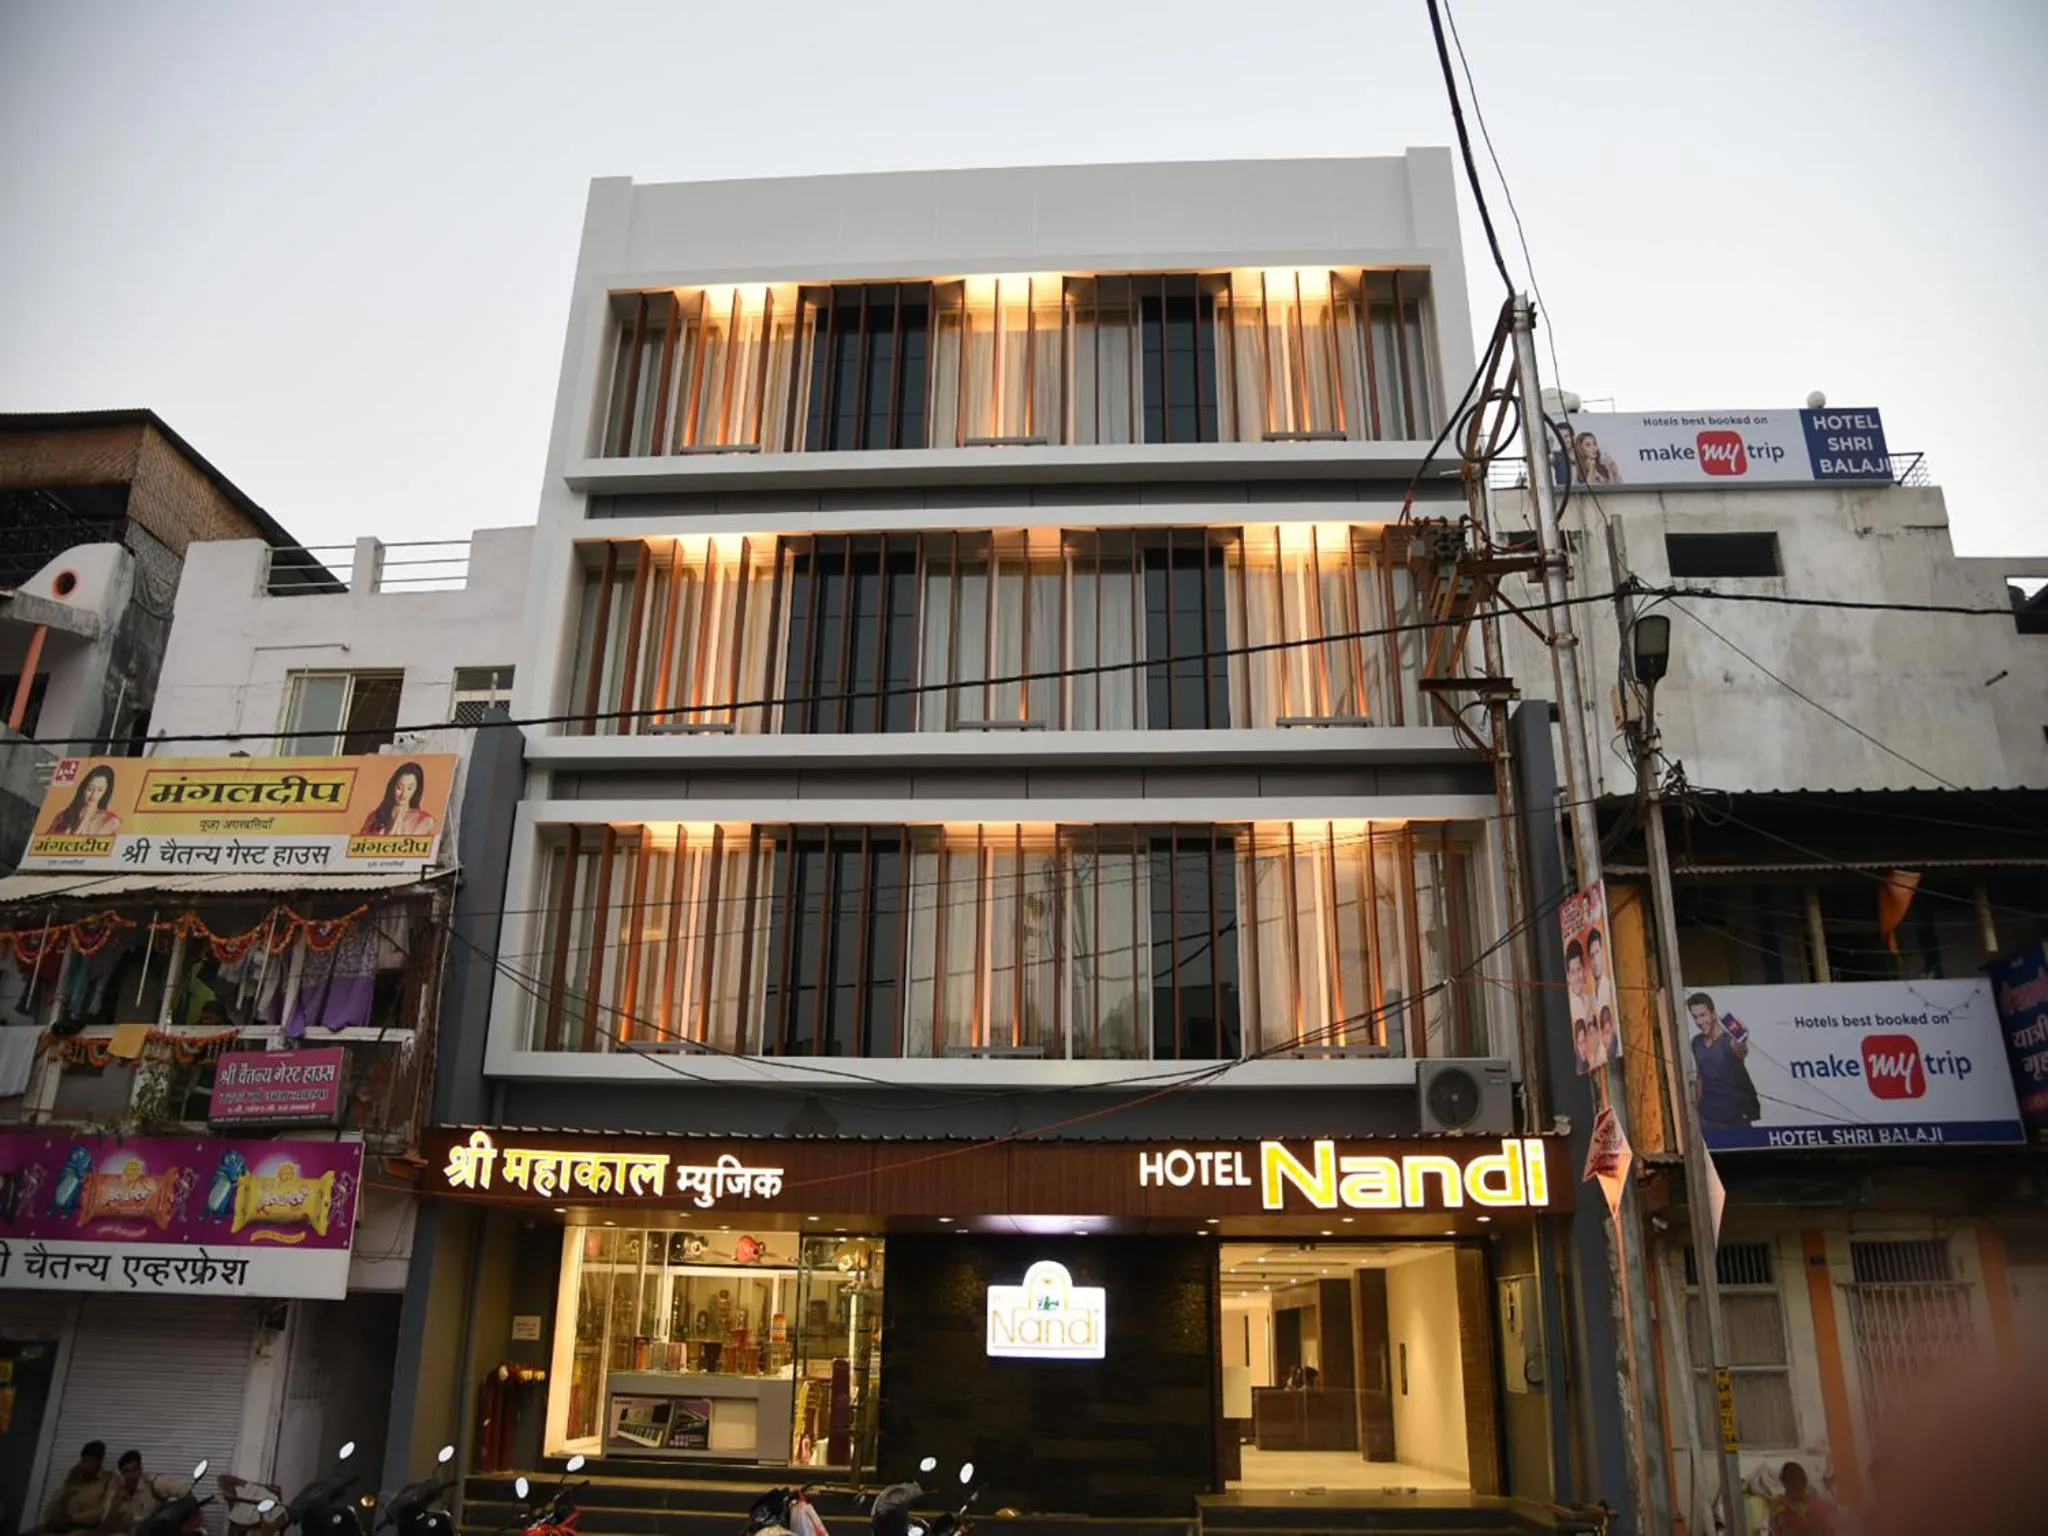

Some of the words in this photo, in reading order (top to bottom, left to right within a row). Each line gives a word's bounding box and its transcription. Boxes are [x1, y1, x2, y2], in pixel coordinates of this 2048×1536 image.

[1643, 416, 1679, 427] Hotels
[1681, 416, 1705, 426] best
[1708, 415, 1751, 426] booked
[1753, 417, 1769, 426] on
[1813, 414, 1880, 430] HOTEL
[1639, 444, 1695, 462] make
[1701, 440, 1741, 473] my
[1746, 442, 1785, 464] trip
[1827, 436, 1873, 452] SHRI
[1820, 457, 1893, 474] BALAJI
[150, 777, 346, 805] मंगलदीप
[34, 839, 110, 856] मंगलदीप
[122, 838, 151, 865] श्री
[161, 836, 220, 866] चैतन्य
[226, 838, 267, 866] गेस्ट
[273, 844, 332, 866] हाउस
[351, 839, 428, 856] मंगलदीप
[1795, 1015, 1839, 1028] Hotels
[1842, 1014, 1872, 1027] best
[1874, 1013, 1928, 1026] booked
[1931, 1015, 1950, 1026] on
[218, 1063, 236, 1086] श्री
[239, 1062, 272, 1085] चैतन्य
[274, 1061, 301, 1083] गेस्ट
[303, 1064, 336, 1084] हाउस
[1790, 1053, 1861, 1079] make
[1867, 1052, 1917, 1096] my
[1924, 1053, 1972, 1081] trip
[1768, 1130, 1830, 1147] HOTEL
[1833, 1128, 1874, 1146] SHRI
[1878, 1126, 1944, 1145] BALAJI
[443, 1129, 498, 1191] श्री
[502, 1147, 671, 1198] महाकाल
[676, 1154, 786, 1208] म्युजिक
[1139, 1149, 1252, 1187] HOTEL
[1260, 1138, 1549, 1210] Nandi
[24, 1243, 112, 1282] चैतन्य
[123, 1247, 249, 1288] एव्हरफ्रेश
[992, 1307, 1100, 1345] Nandi
